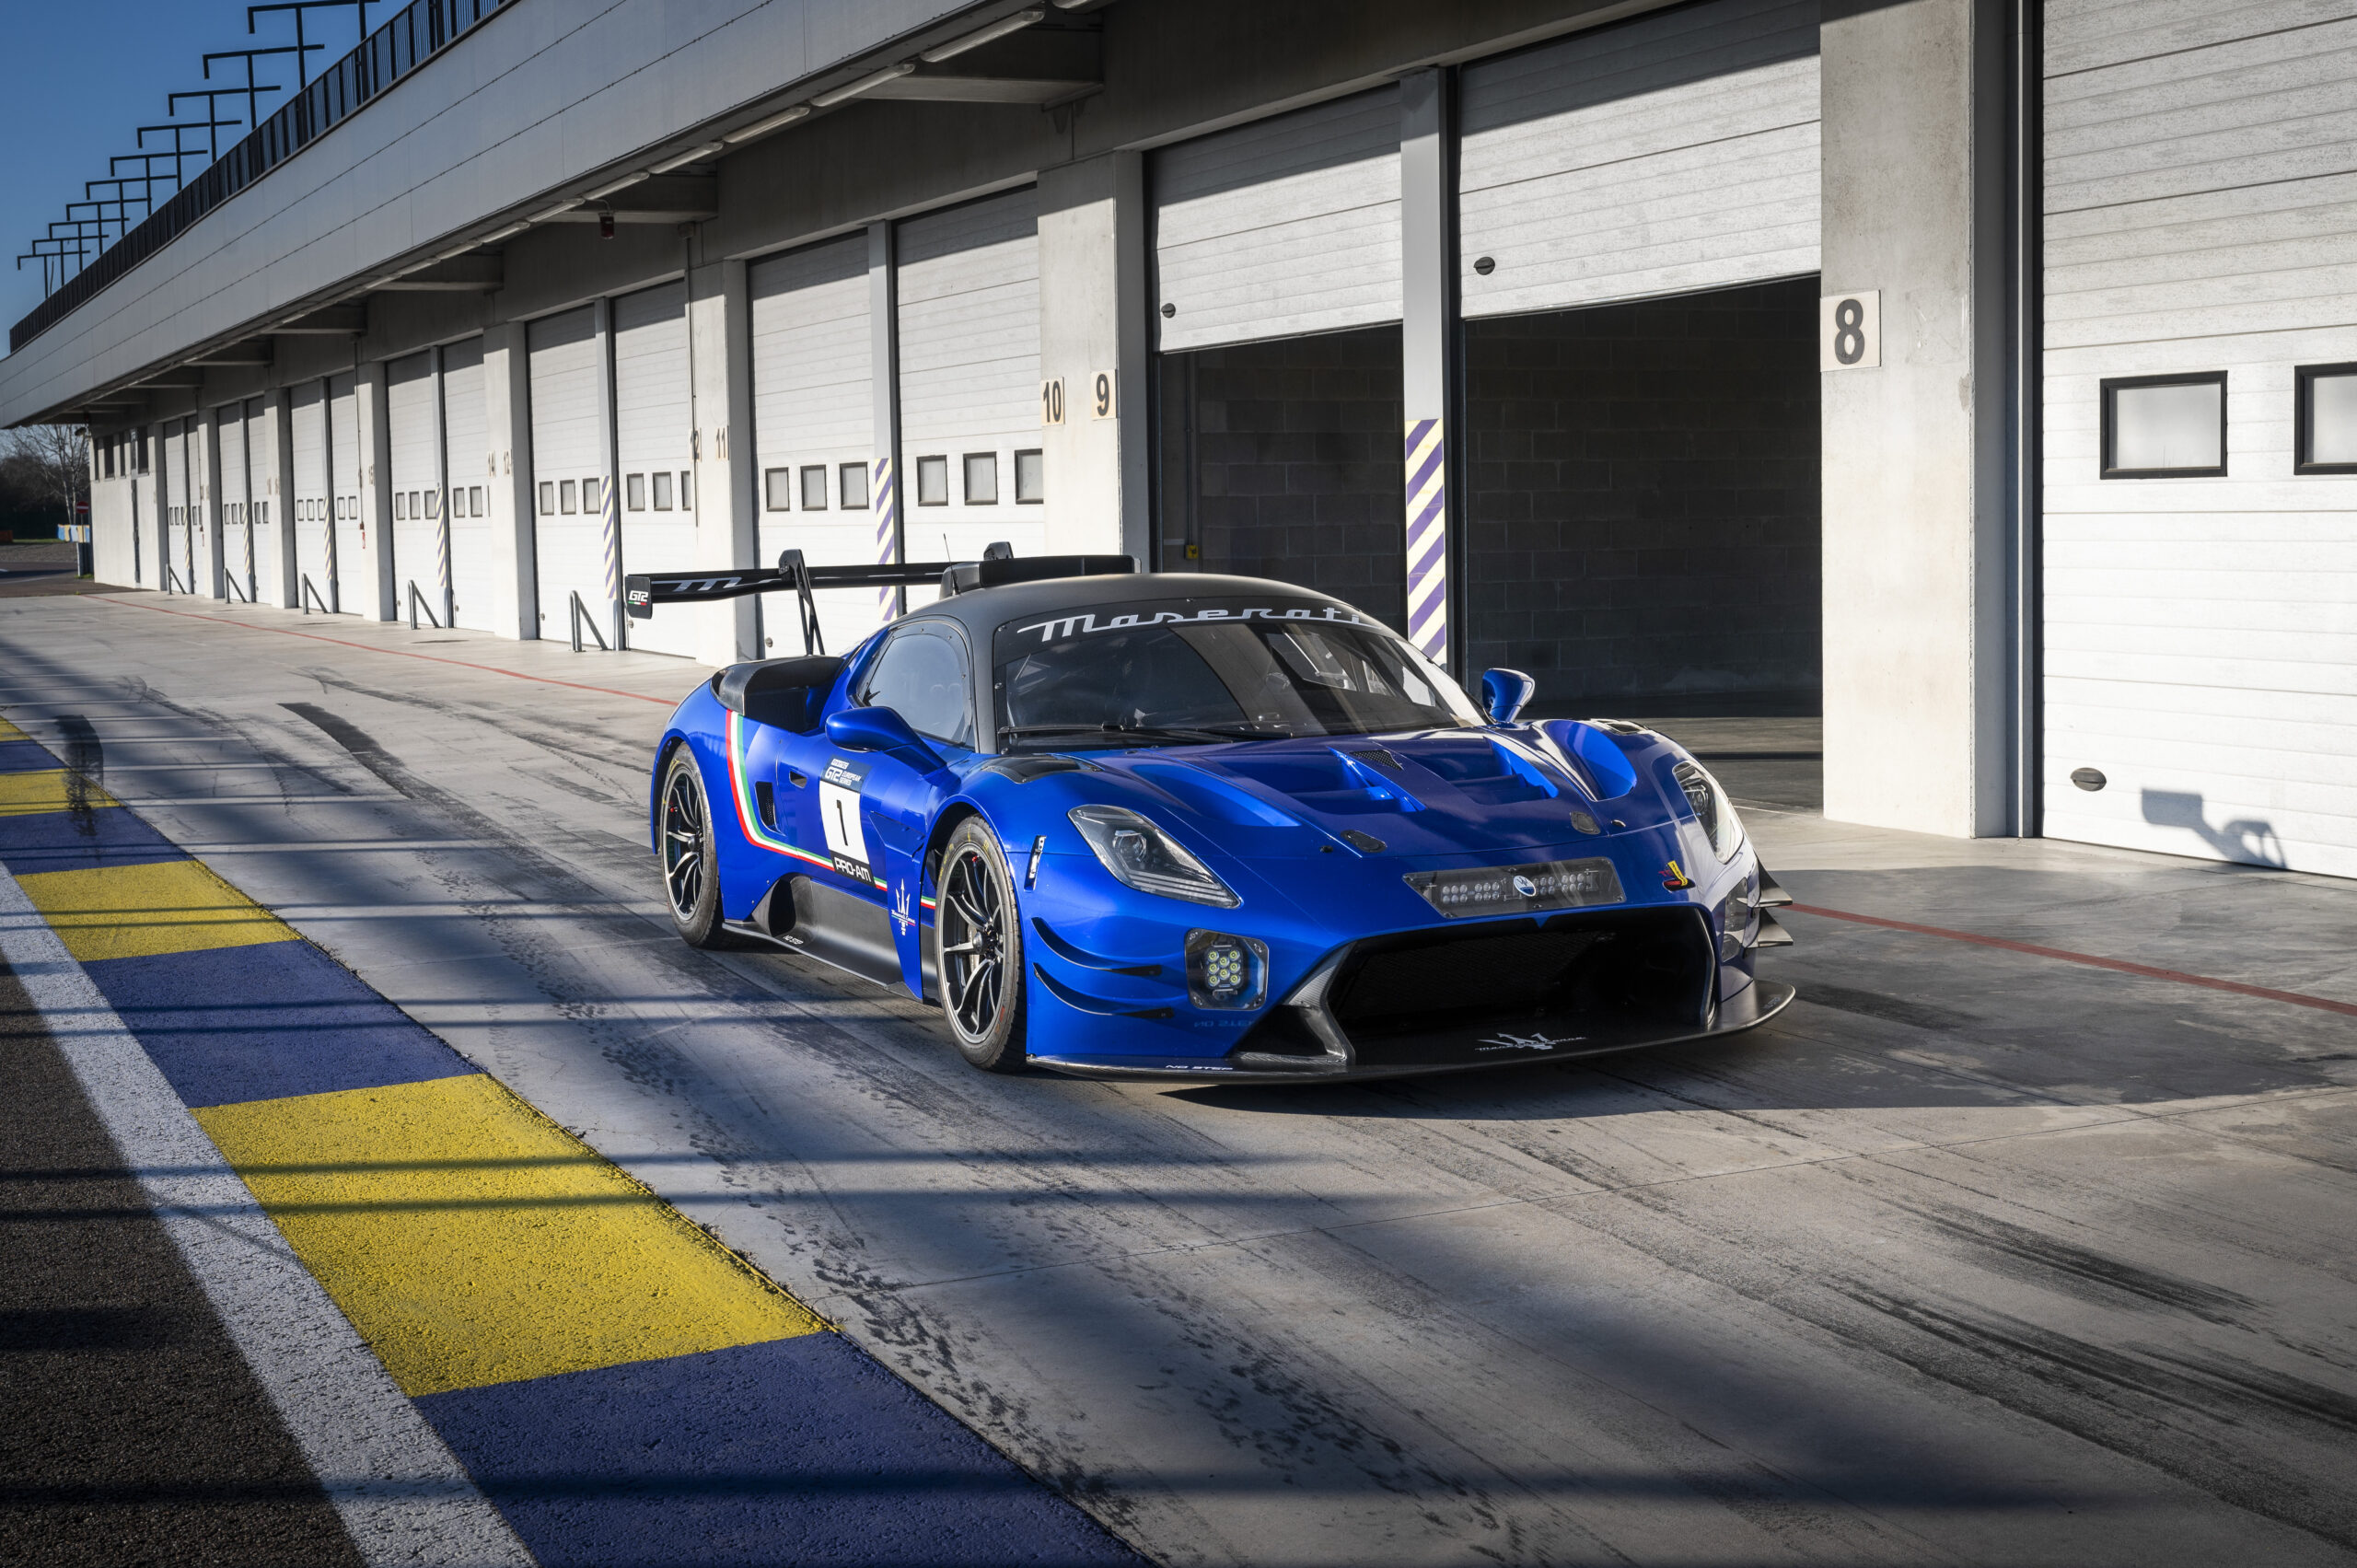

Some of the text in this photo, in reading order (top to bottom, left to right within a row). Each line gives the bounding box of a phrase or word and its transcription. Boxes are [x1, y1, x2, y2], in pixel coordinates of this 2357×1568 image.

[1834, 298, 1865, 366] 8
[1043, 380, 1062, 423] 10
[1096, 373, 1110, 417] 9
[716, 427, 726, 459] 11
[628, 589, 649, 602] GT2
[1016, 607, 1383, 643] Maserati
[824, 766, 843, 783] GT2
[836, 799, 848, 846] 1
[834, 856, 872, 882] PRO-AM
